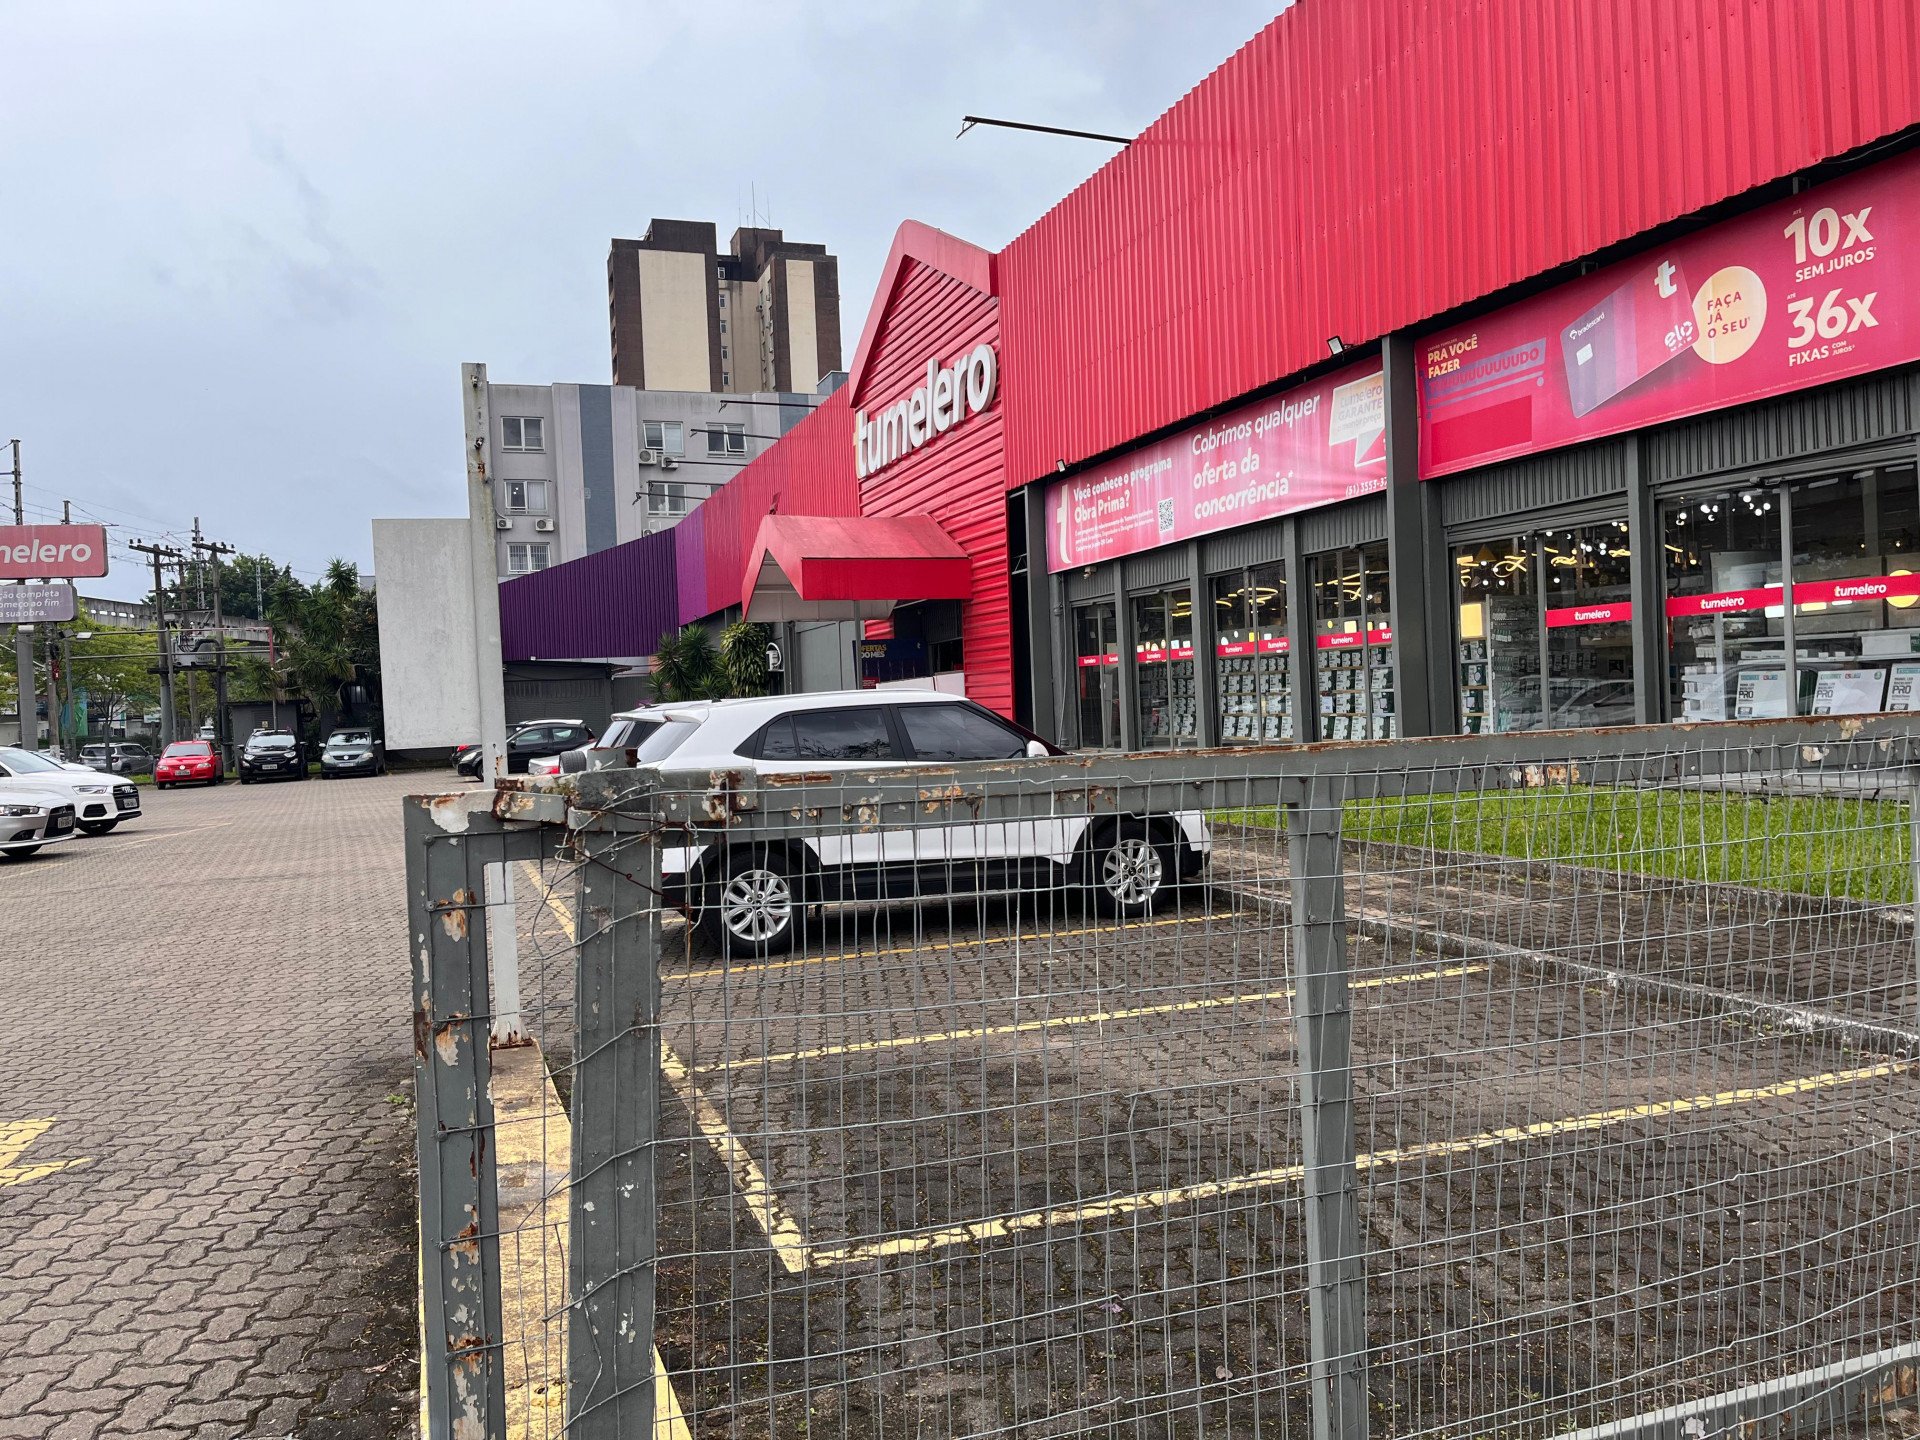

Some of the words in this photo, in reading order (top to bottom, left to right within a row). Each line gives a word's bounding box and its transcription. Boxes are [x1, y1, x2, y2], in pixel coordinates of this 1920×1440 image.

[1784, 206, 1875, 265] 10x
[1653, 259, 1678, 299] t
[1795, 262, 1825, 283] SEM
[1706, 291, 1743, 312] FAÇA
[1577, 311, 1606, 337] bradescard
[1707, 310, 1723, 326] JÁ
[1787, 287, 1880, 349] 36x
[1664, 320, 1694, 347] elo
[1707, 328, 1717, 339] O
[1427, 347, 1449, 365] PRA
[1449, 333, 1479, 357] VOCÊ
[1789, 345, 1830, 368] FIXAS
[1831, 340, 1847, 350] COM
[1428, 358, 1461, 379] FAZER
[853, 344, 997, 479] tumelero
[1338, 397, 1383, 422] GARANTE
[1192, 420, 1252, 456] Cobrimos
[1254, 394, 1320, 439] qualquer
[1193, 460, 1237, 490] oferta
[1240, 447, 1260, 475] da
[1073, 484, 1092, 502] Você
[1091, 475, 1123, 496] conhece
[1123, 473, 1130, 485] o
[1130, 457, 1173, 487] programa
[1074, 503, 1097, 524] Obra
[1097, 489, 1131, 517] Prima?
[16, 589, 60, 599] completa
[1834, 583, 1887, 597] tumelero
[6, 610, 21, 618] sua
[23, 608, 47, 616] obra.
[1700, 596, 1745, 609] tumelero
[1574, 609, 1611, 621] tumelero
[1225, 645, 1243, 653] tumelero
[1268, 640, 1288, 649] tumelero
[1331, 636, 1354, 645] tumelero
[1738, 690, 1754, 698] PRO
[1816, 689, 1834, 698] PRO
[1891, 685, 1912, 695] PRO
